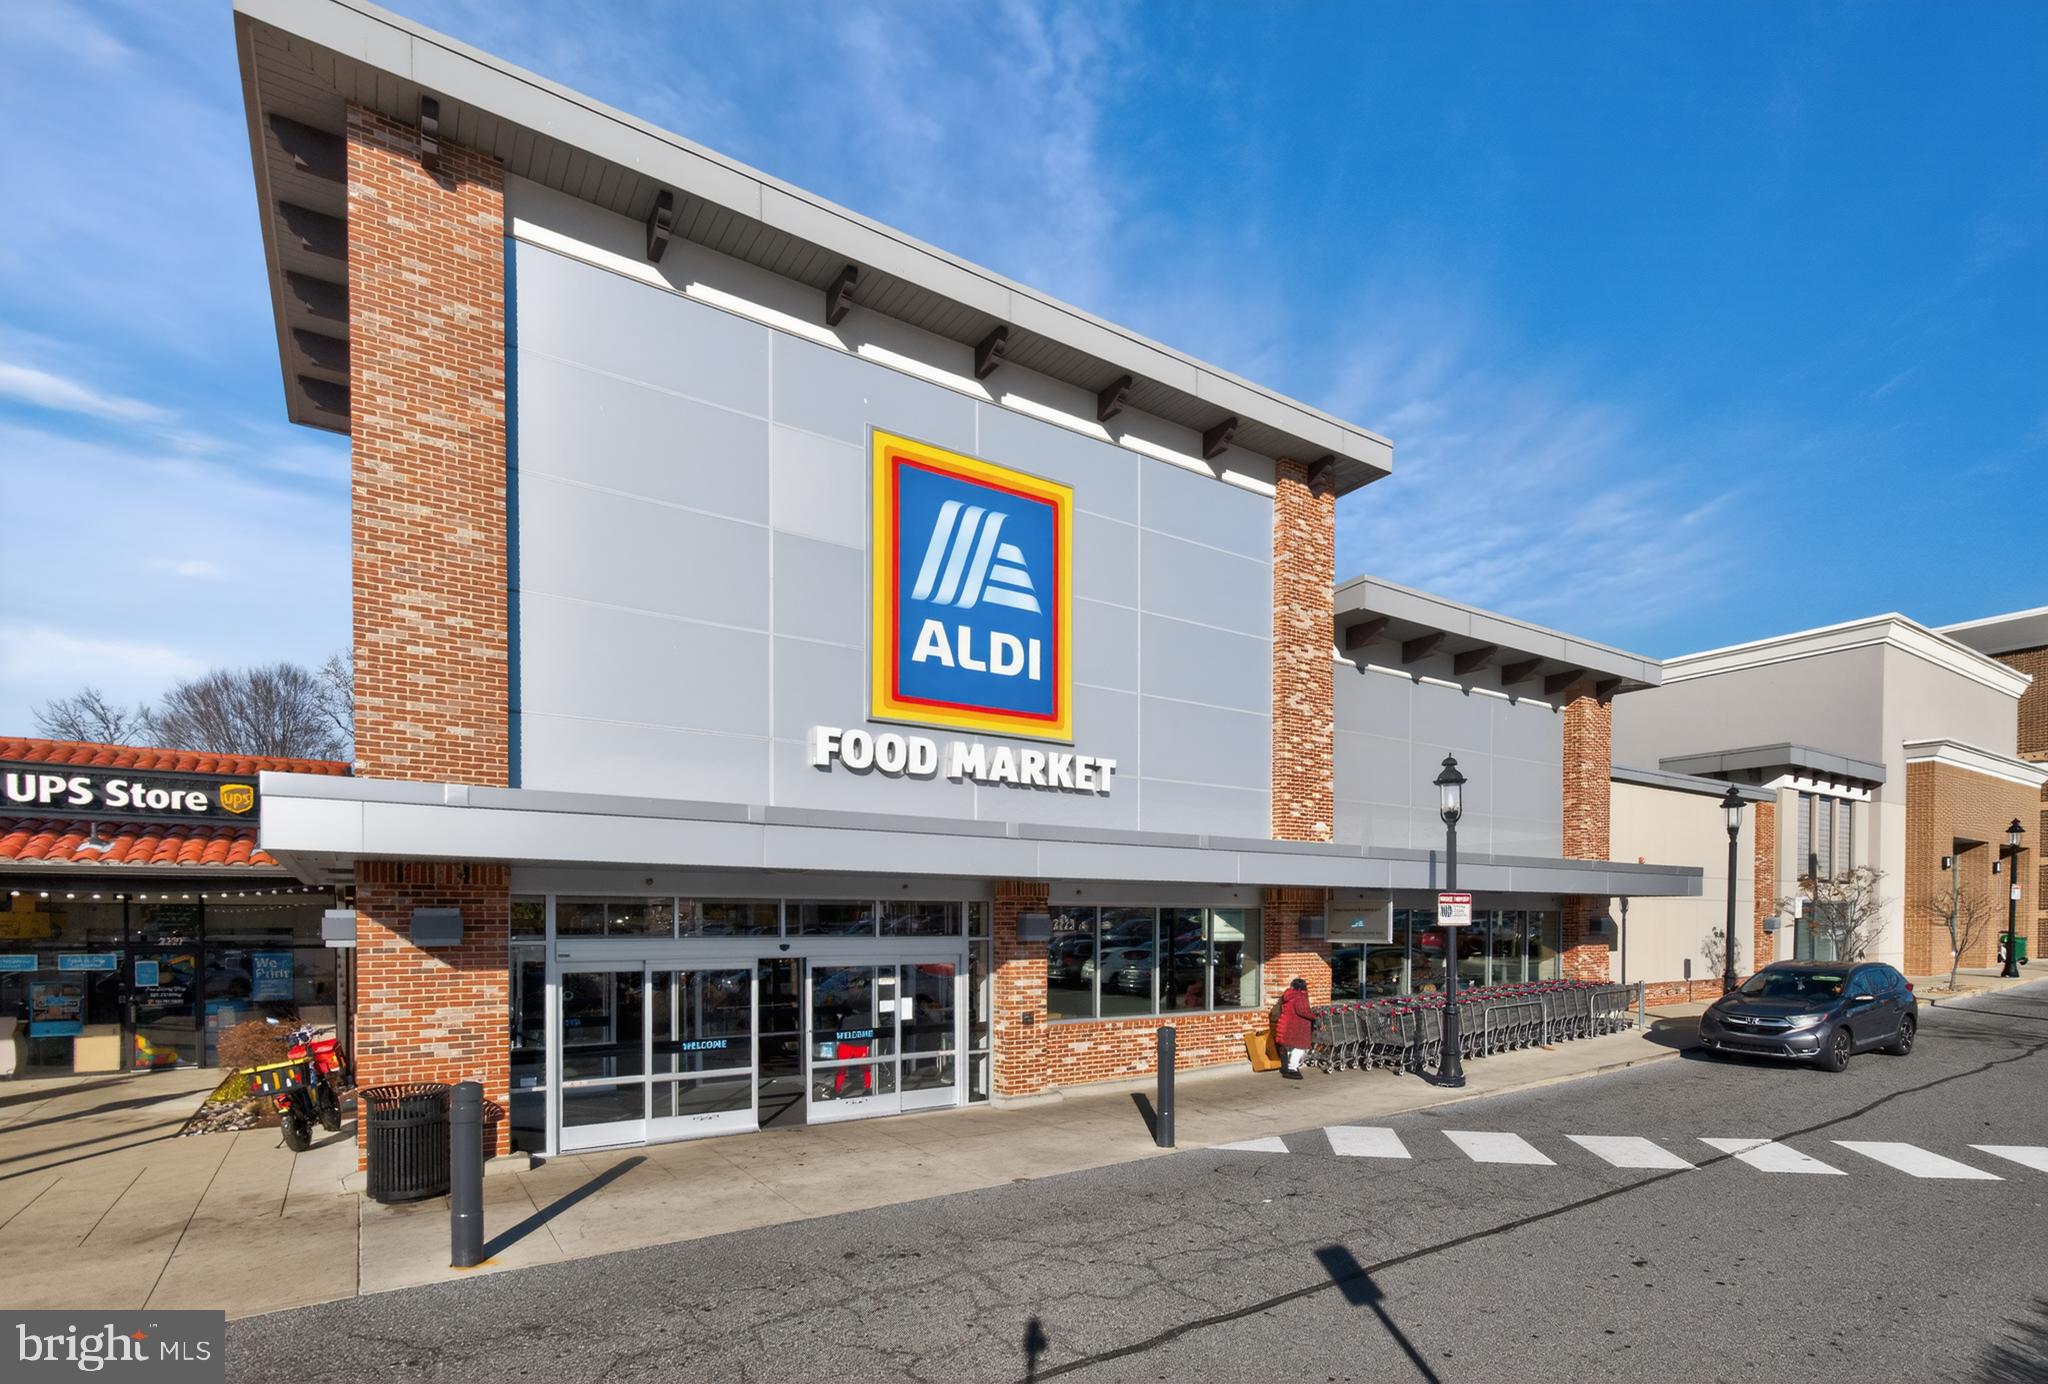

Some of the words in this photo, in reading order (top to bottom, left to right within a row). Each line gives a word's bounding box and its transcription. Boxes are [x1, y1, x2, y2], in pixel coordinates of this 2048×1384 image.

[911, 618, 1041, 681] ALDI
[810, 725, 939, 780] FOOD
[947, 740, 1117, 797] MARKET
[6, 773, 95, 806] UPS
[105, 779, 209, 812] Store
[223, 792, 251, 809] ups
[254, 957, 278, 968] We
[255, 968, 290, 979] Print
[836, 1029, 874, 1040] WELCOME
[682, 1039, 728, 1051] WELCOME
